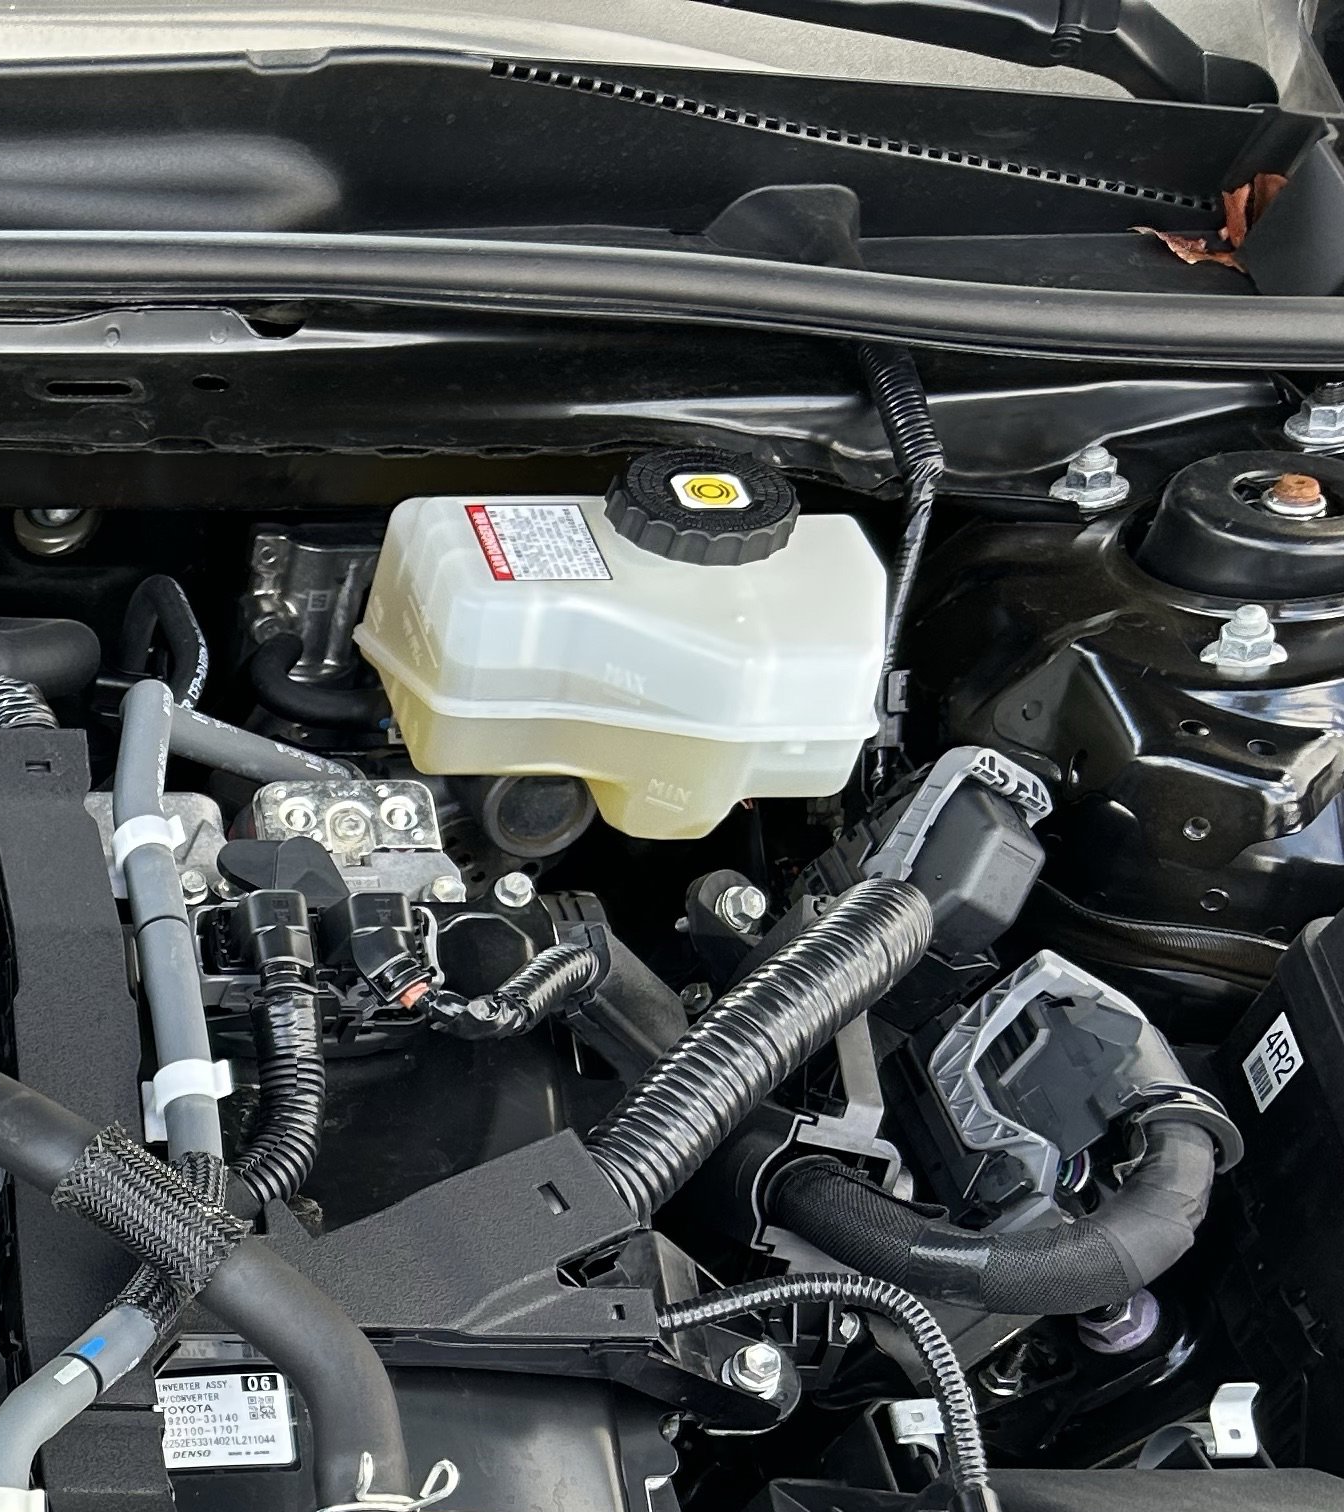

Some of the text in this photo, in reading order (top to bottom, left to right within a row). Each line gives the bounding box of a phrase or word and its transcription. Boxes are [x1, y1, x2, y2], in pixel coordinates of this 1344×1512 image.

[1266, 1030, 1295, 1085] 4R2
[158, 1382, 201, 1392] INVERTER
[247, 1376, 271, 1391] 06
[158, 1393, 220, 1404] W/CONVERTER
[162, 1404, 213, 1415] TOYOTA
[166, 1413, 239, 1425] 9200-33140
[165, 1424, 240, 1438] 32100-1707
[172, 1450, 212, 1459] DENSO
